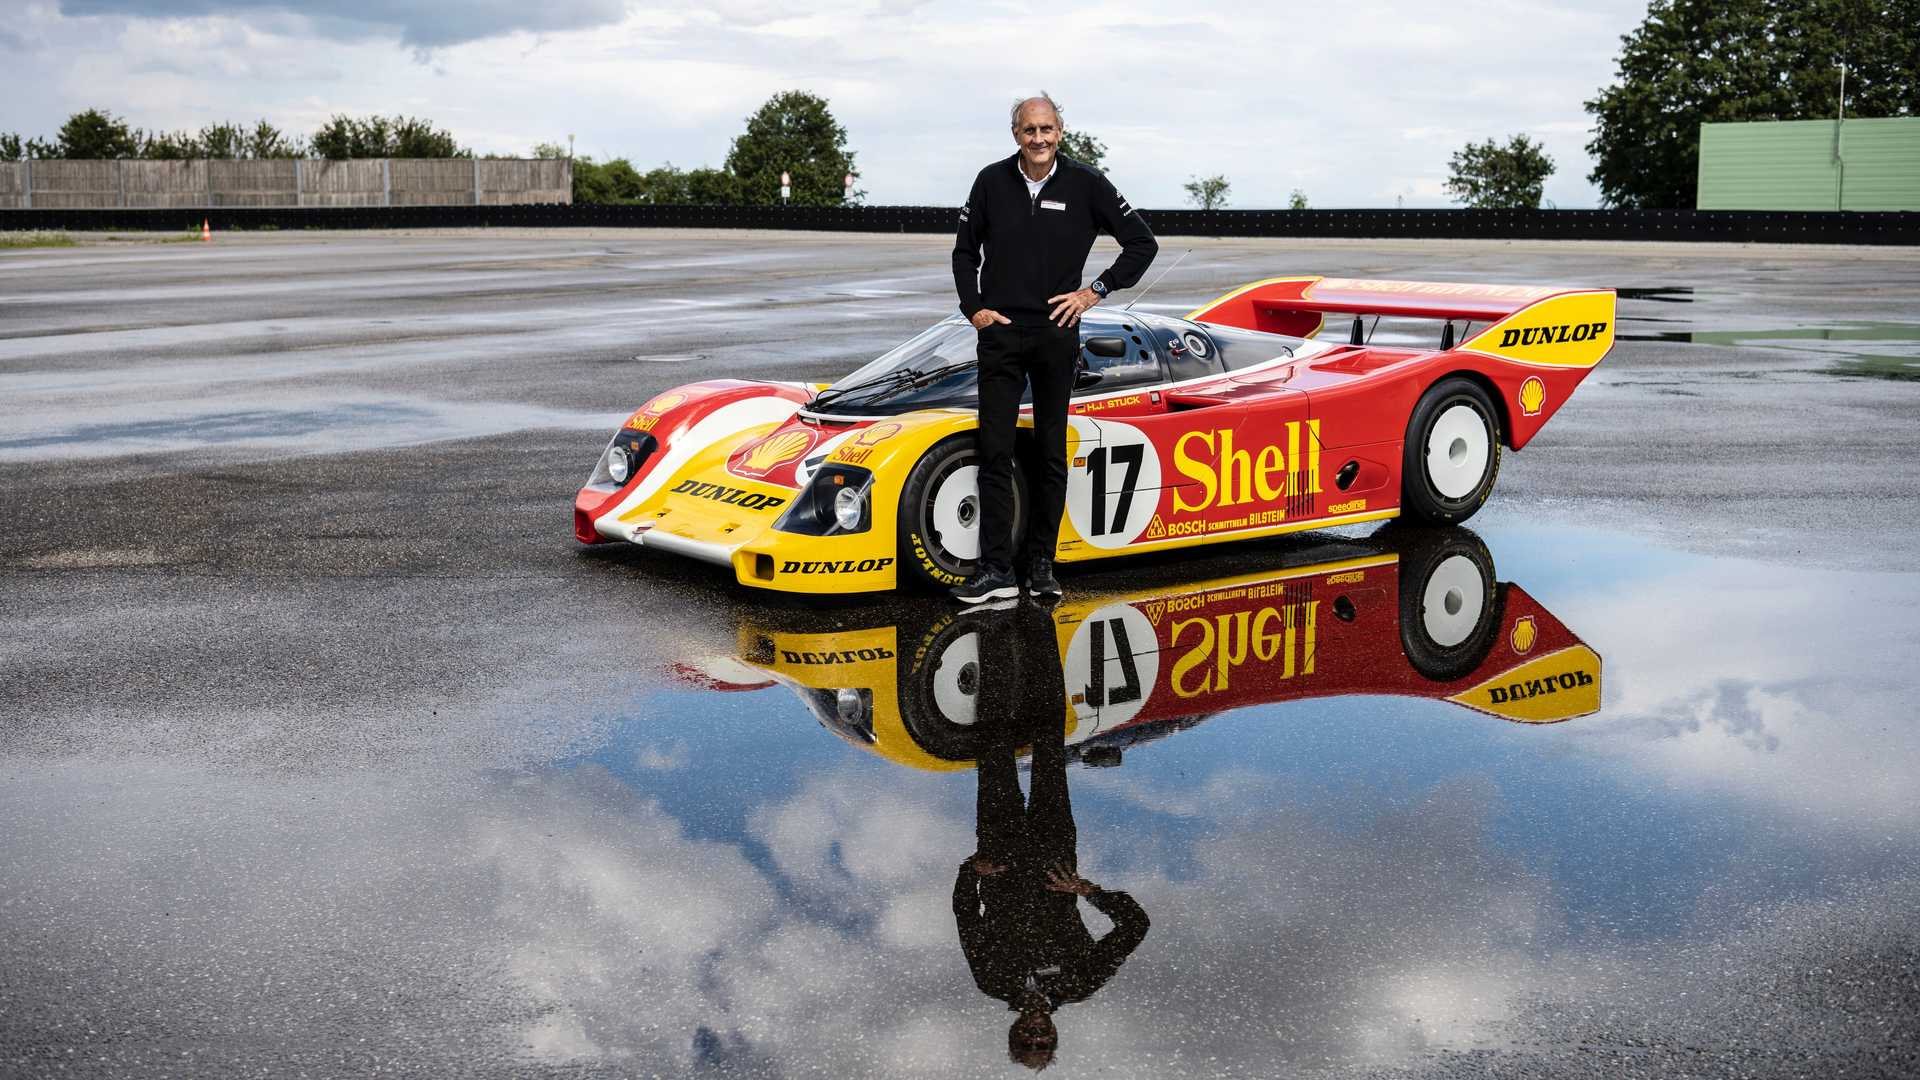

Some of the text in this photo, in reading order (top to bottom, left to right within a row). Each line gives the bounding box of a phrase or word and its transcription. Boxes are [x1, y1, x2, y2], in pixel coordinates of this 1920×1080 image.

[1499, 322, 1607, 348] DUNLOP
[1107, 396, 1140, 408] STUCK
[629, 415, 659, 431] Shell
[837, 446, 873, 464] Shell
[1173, 418, 1323, 516] Shell
[671, 479, 786, 511] DUNLOP
[1086, 443, 1145, 537] 17
[1168, 520, 1206, 536] BOSCH
[1249, 509, 1286, 525] BILSTEIN
[779, 558, 894, 574] DUNLOP
[911, 533, 967, 586] DUNLOP
